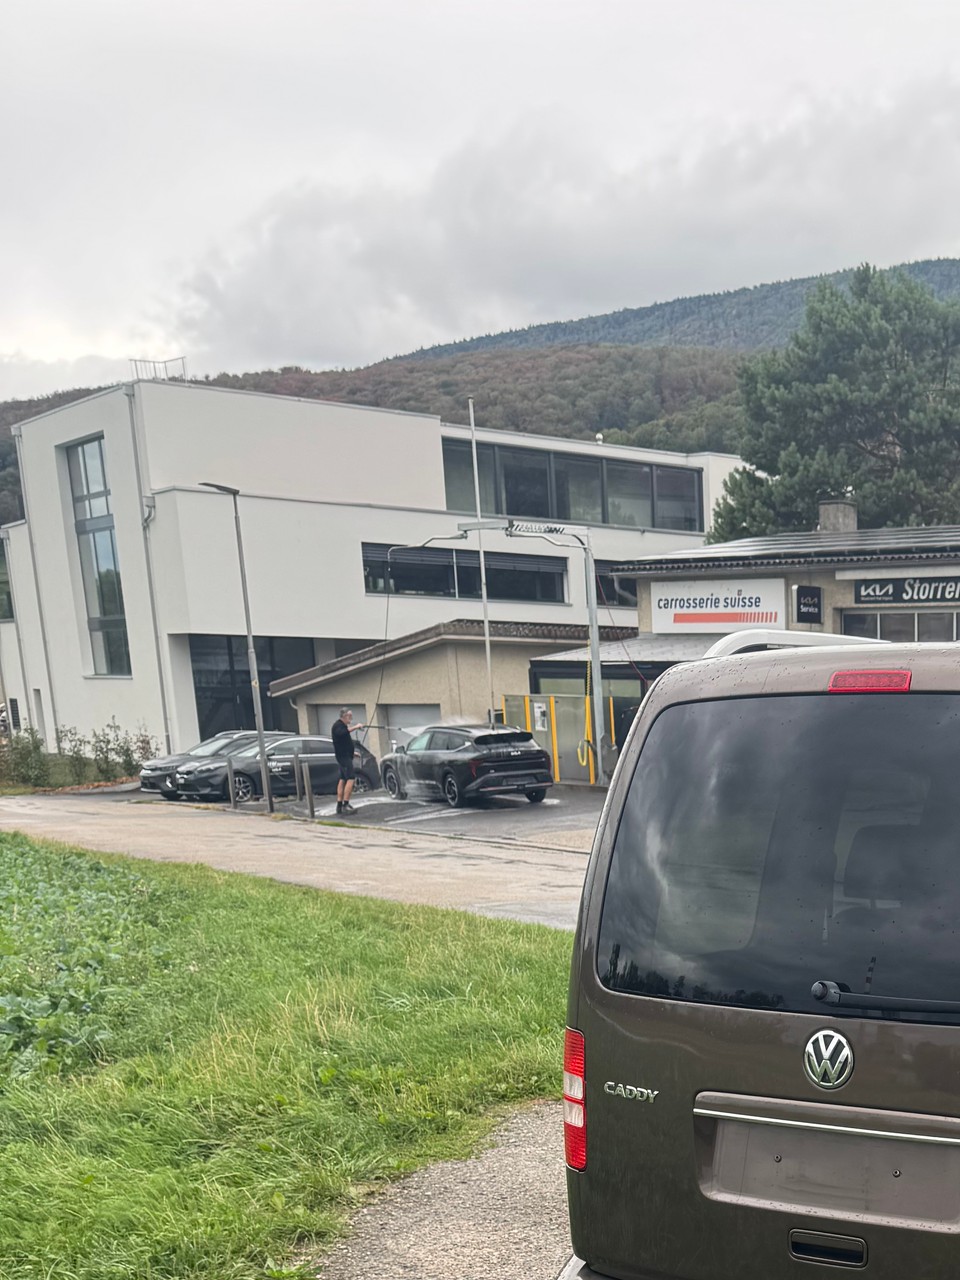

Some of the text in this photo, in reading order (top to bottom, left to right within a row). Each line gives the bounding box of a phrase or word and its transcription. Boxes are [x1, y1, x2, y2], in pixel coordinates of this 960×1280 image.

[657, 589, 761, 610] carrosserie suisse
[603, 1081, 659, 1104] CADDY
